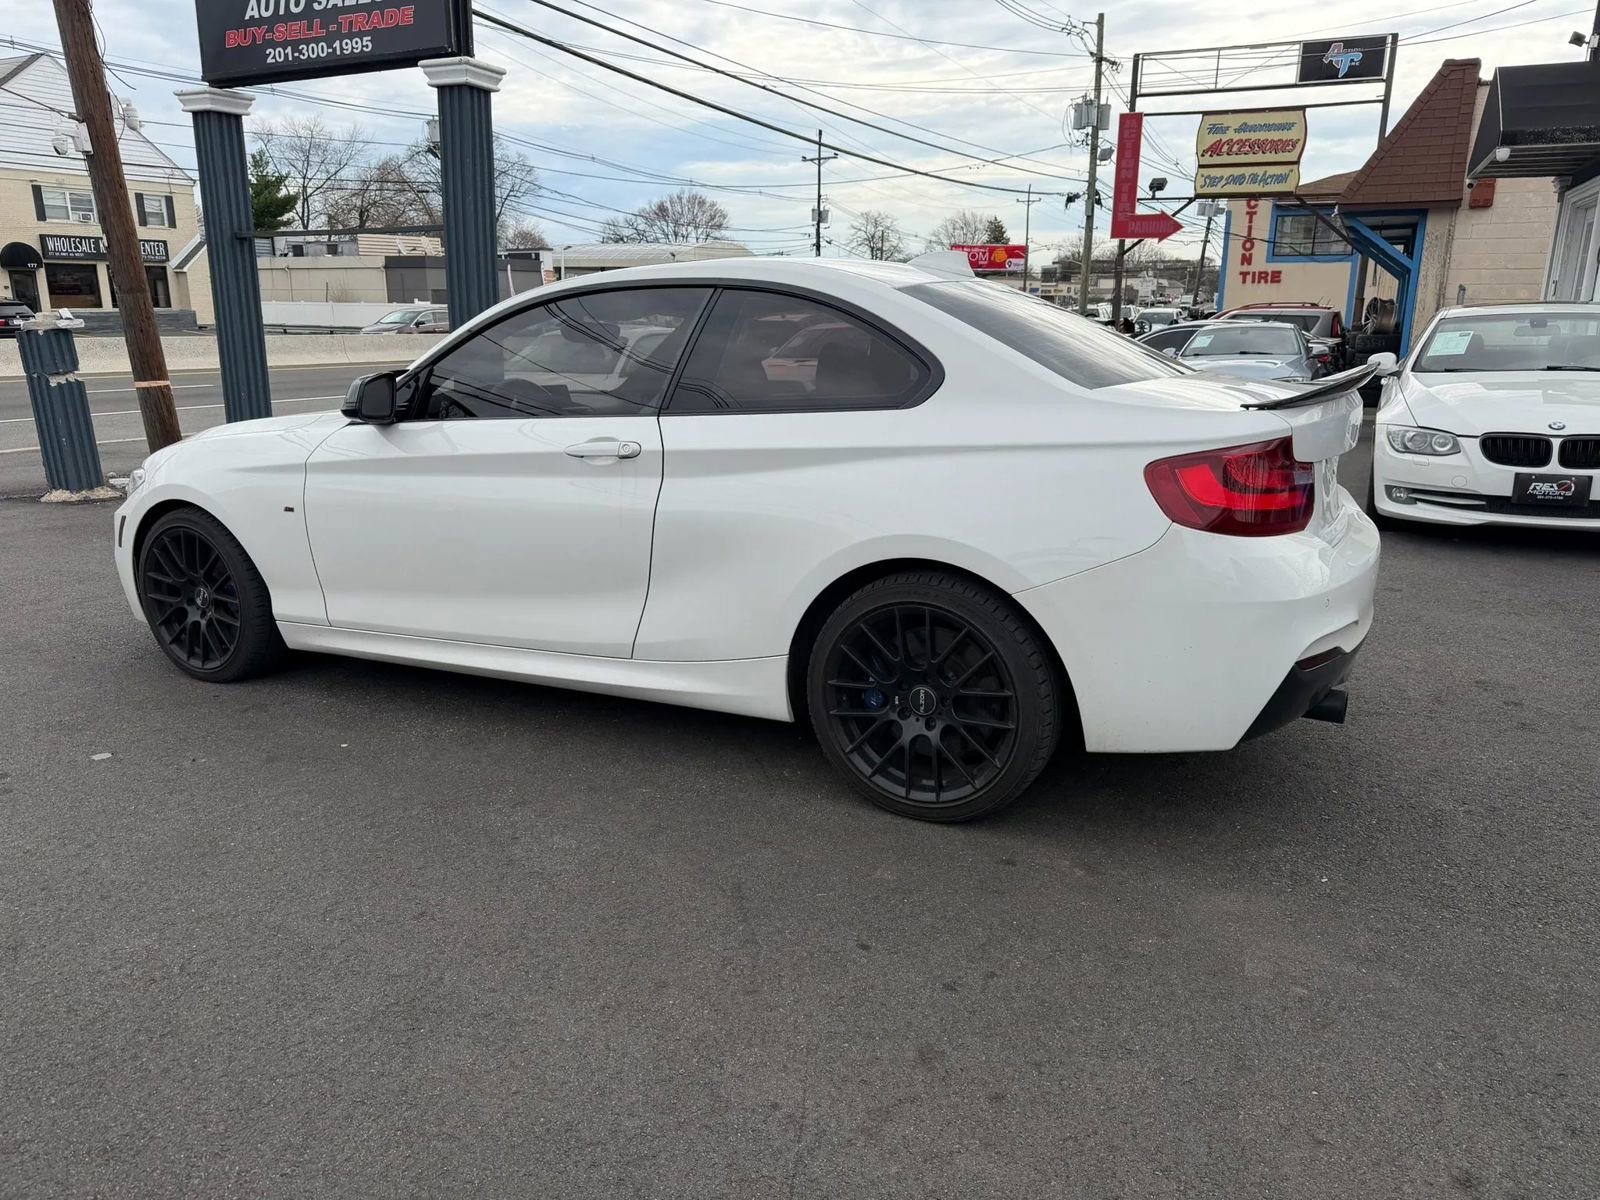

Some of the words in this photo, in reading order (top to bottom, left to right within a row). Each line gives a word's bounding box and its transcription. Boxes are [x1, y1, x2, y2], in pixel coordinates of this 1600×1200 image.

[266, 36, 373, 63] 201-300-1995
[1201, 138, 1300, 157] ACCESSORIES
[1241, 199, 1259, 266] CTION
[46, 236, 96, 253] WHOLESALE
[140, 241, 165, 256] ENTER
[1239, 271, 1282, 284] TIRE
